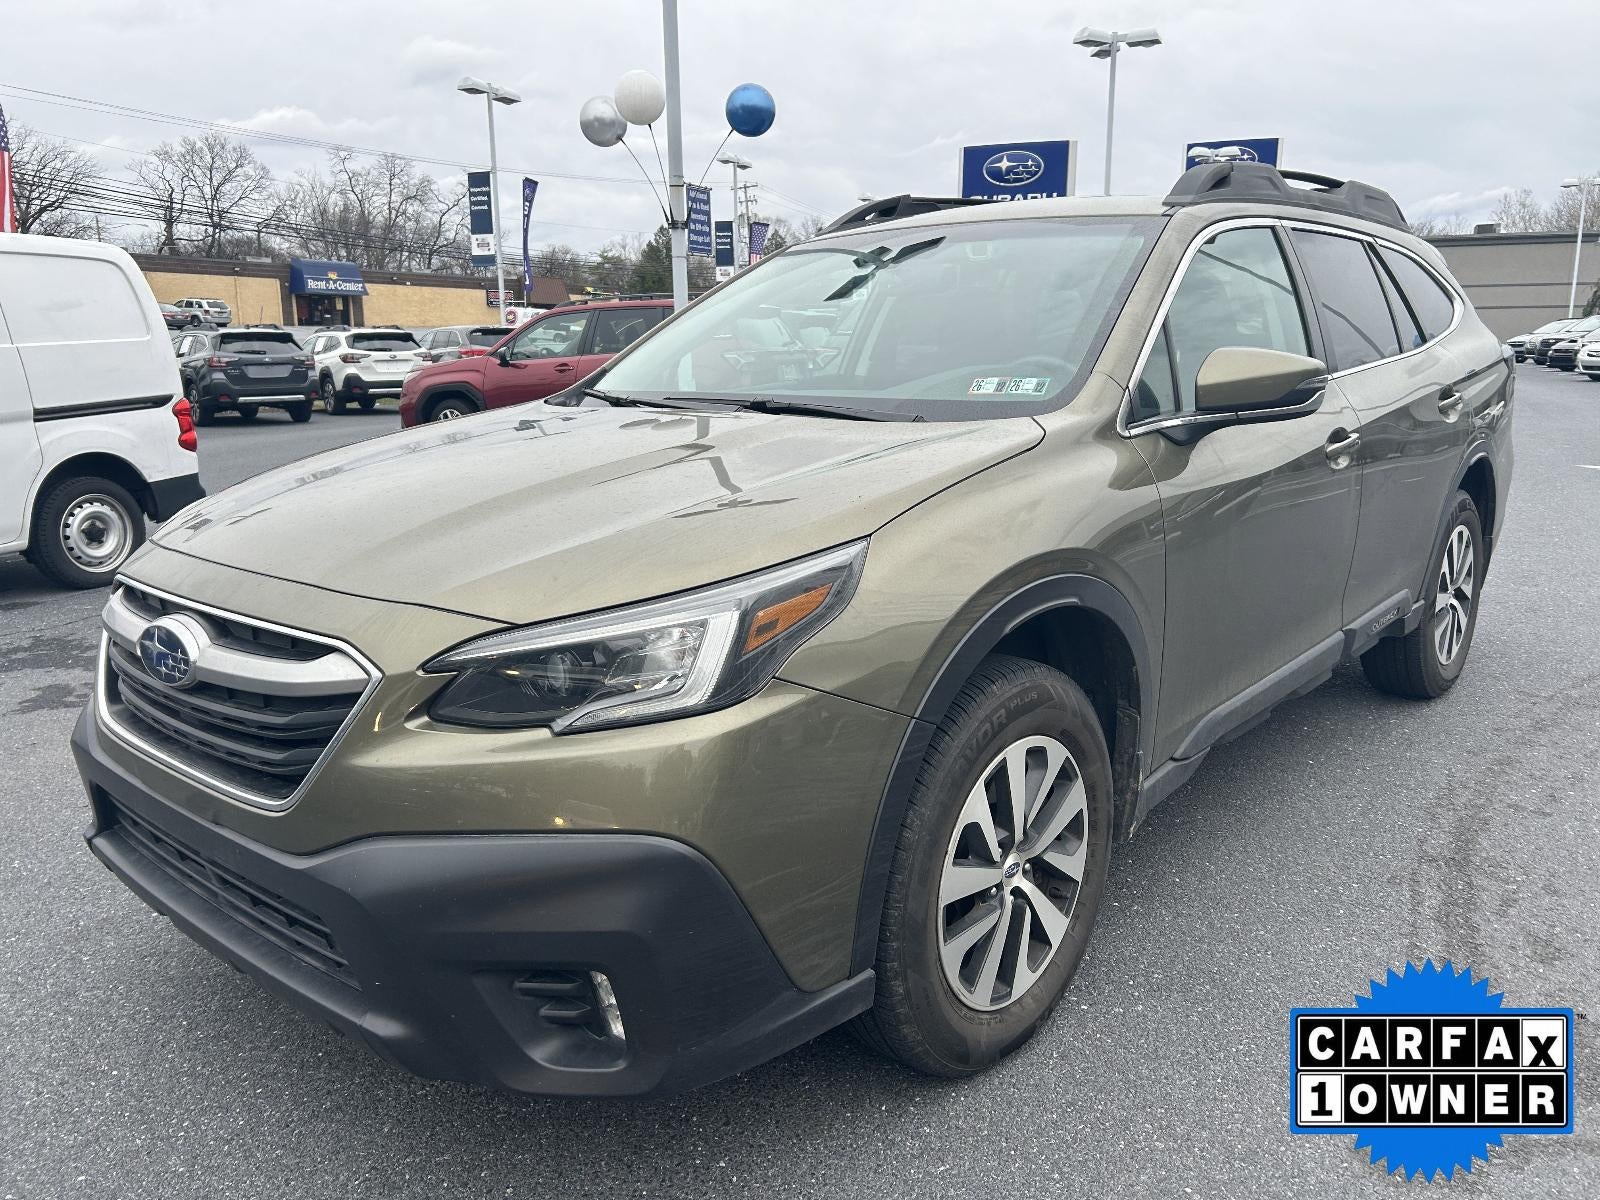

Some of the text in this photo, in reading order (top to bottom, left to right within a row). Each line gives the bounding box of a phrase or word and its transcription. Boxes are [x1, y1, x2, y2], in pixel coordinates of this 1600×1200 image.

[971, 379, 984, 392] 26
[1009, 379, 1023, 392] 26
[1009, 690, 1038, 711] PLUS
